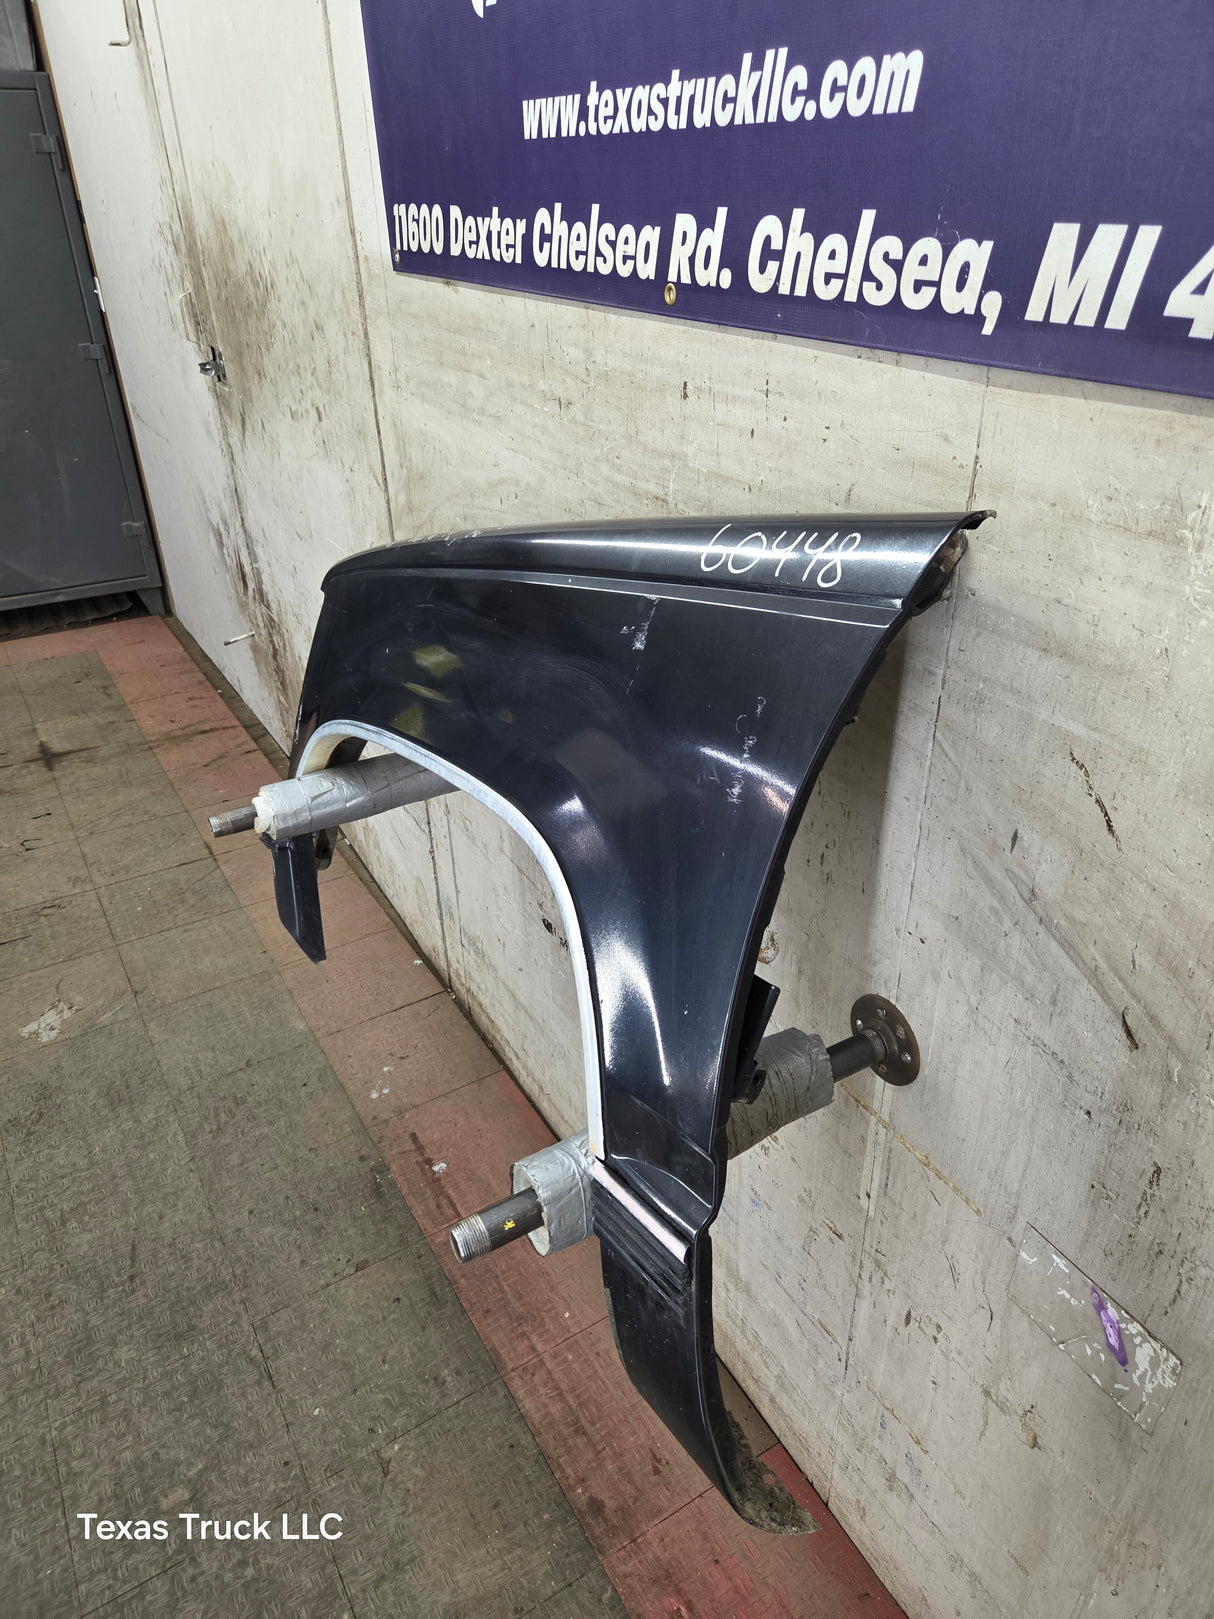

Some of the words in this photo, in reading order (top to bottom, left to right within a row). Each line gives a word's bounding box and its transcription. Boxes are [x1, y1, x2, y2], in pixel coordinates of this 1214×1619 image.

[522, 49, 924, 140] www.texastruckllc.com
[393, 203, 444, 255] 11600
[449, 204, 527, 264] Dexter
[532, 203, 661, 280] Chelsea
[667, 206, 732, 290] Rd.
[748, 208, 1003, 336] Chelsea,
[1024, 223, 1163, 331] MI
[700, 523, 862, 588] 60448
